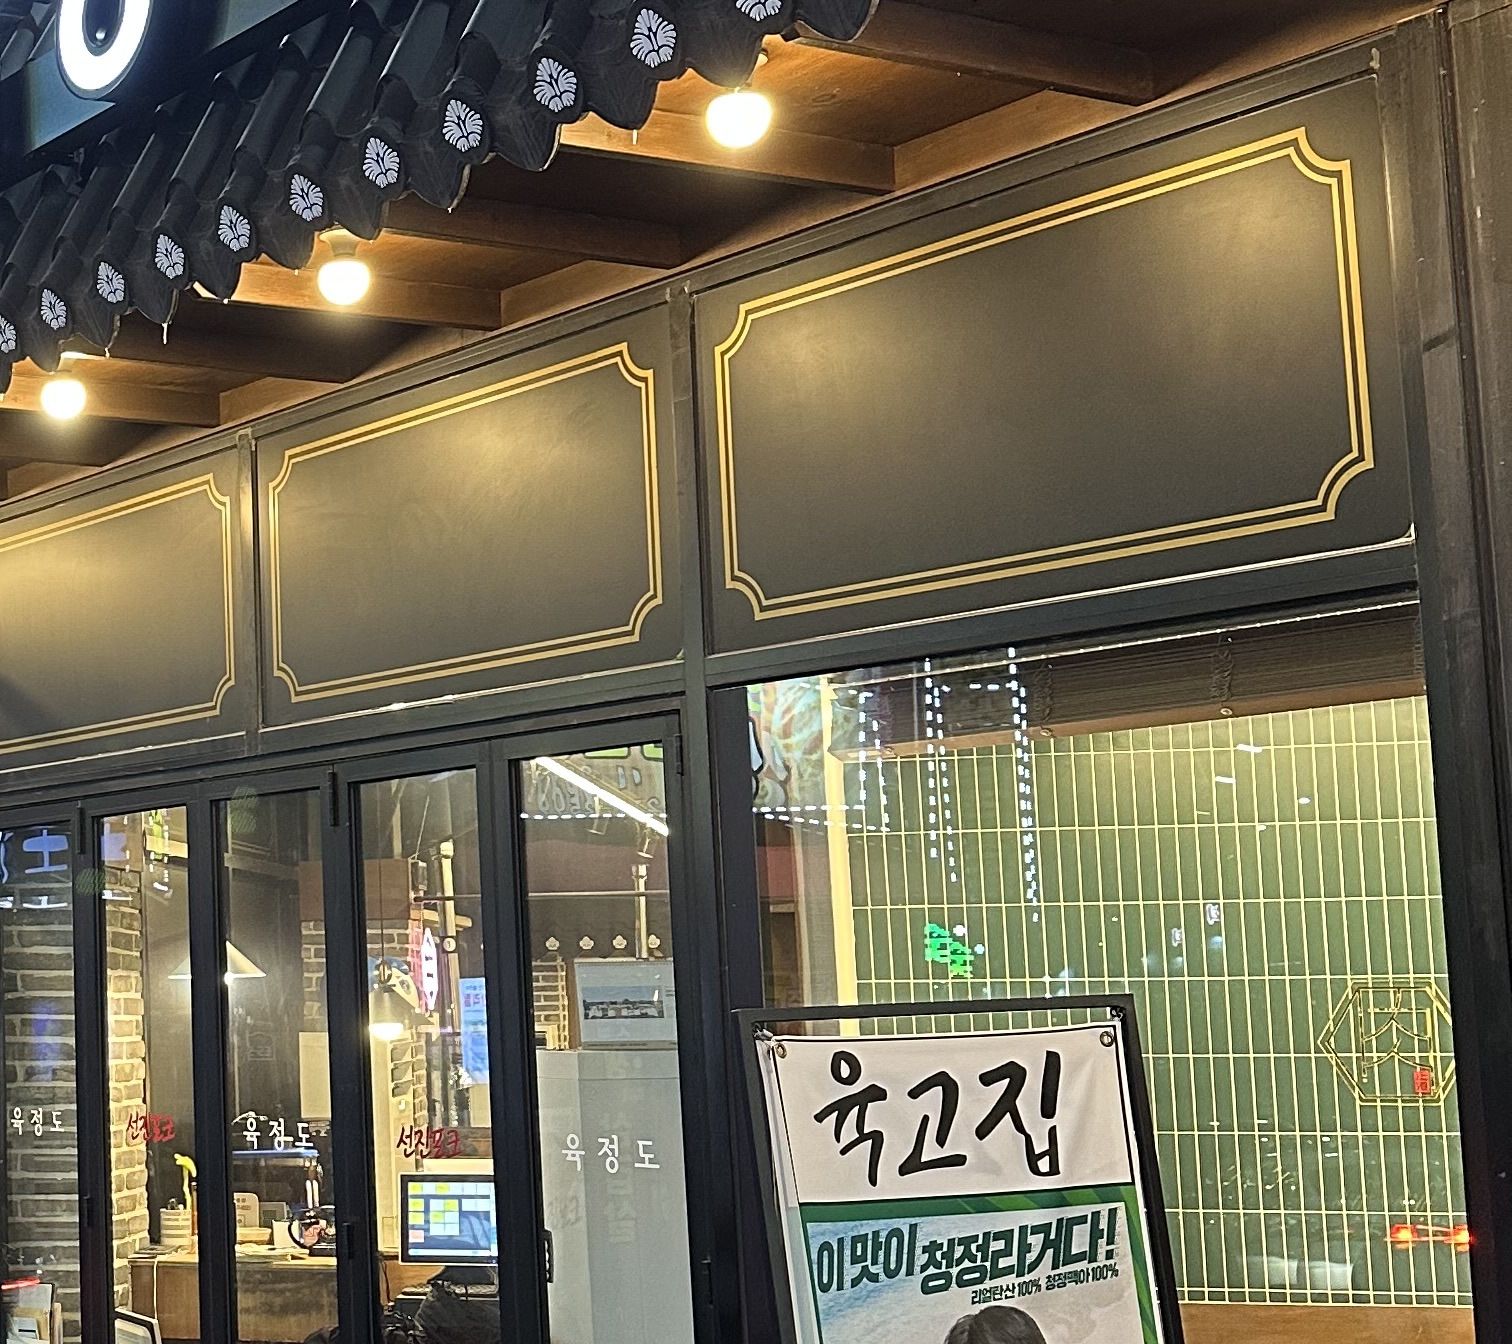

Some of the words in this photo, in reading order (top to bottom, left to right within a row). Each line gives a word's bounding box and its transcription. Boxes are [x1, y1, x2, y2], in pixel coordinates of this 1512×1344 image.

[10, 1107, 65, 1137] 육정도
[242, 1118, 314, 1151] 육정도
[813, 1050, 1062, 1187] 육고집
[562, 1133, 661, 1174] 육정도
[919, 1205, 1119, 1296] 청정라거다!
[971, 1283, 1016, 1306] 리얼탄산
[1017, 1277, 1042, 1298] 100%
[1045, 1269, 1091, 1291] 청정맥아
[1091, 1262, 1119, 1283] 100%
